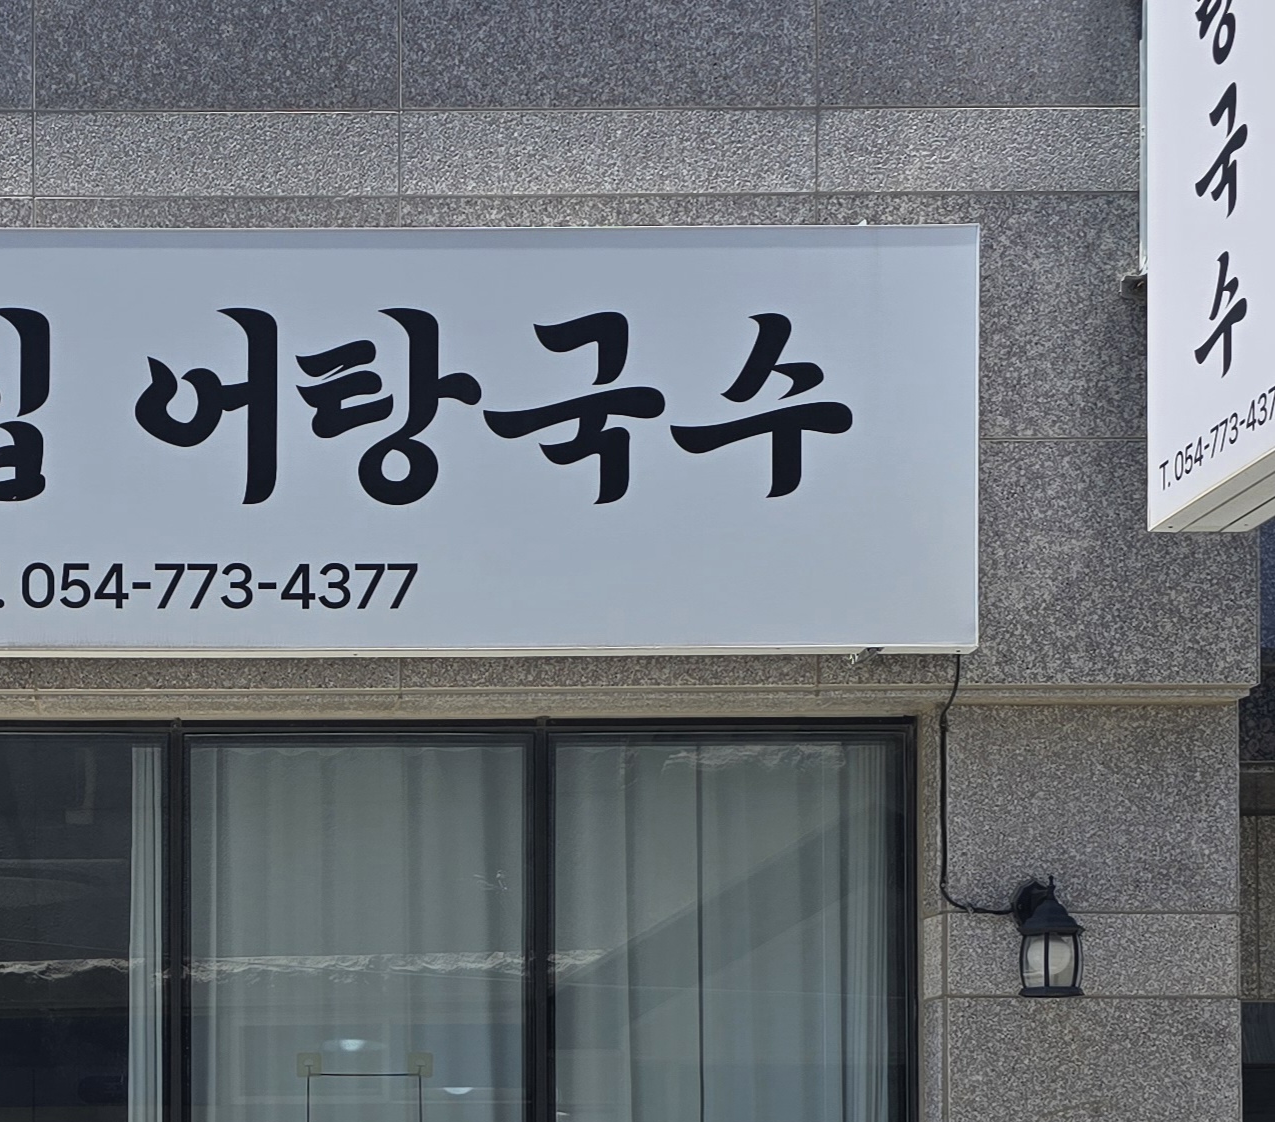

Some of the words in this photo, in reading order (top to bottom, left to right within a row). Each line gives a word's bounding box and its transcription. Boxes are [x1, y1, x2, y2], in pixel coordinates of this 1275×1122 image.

[135, 307, 853, 505] 어탕국수
[1159, 460, 1171, 491] T.
[22, 562, 419, 609] 054-773-4377
